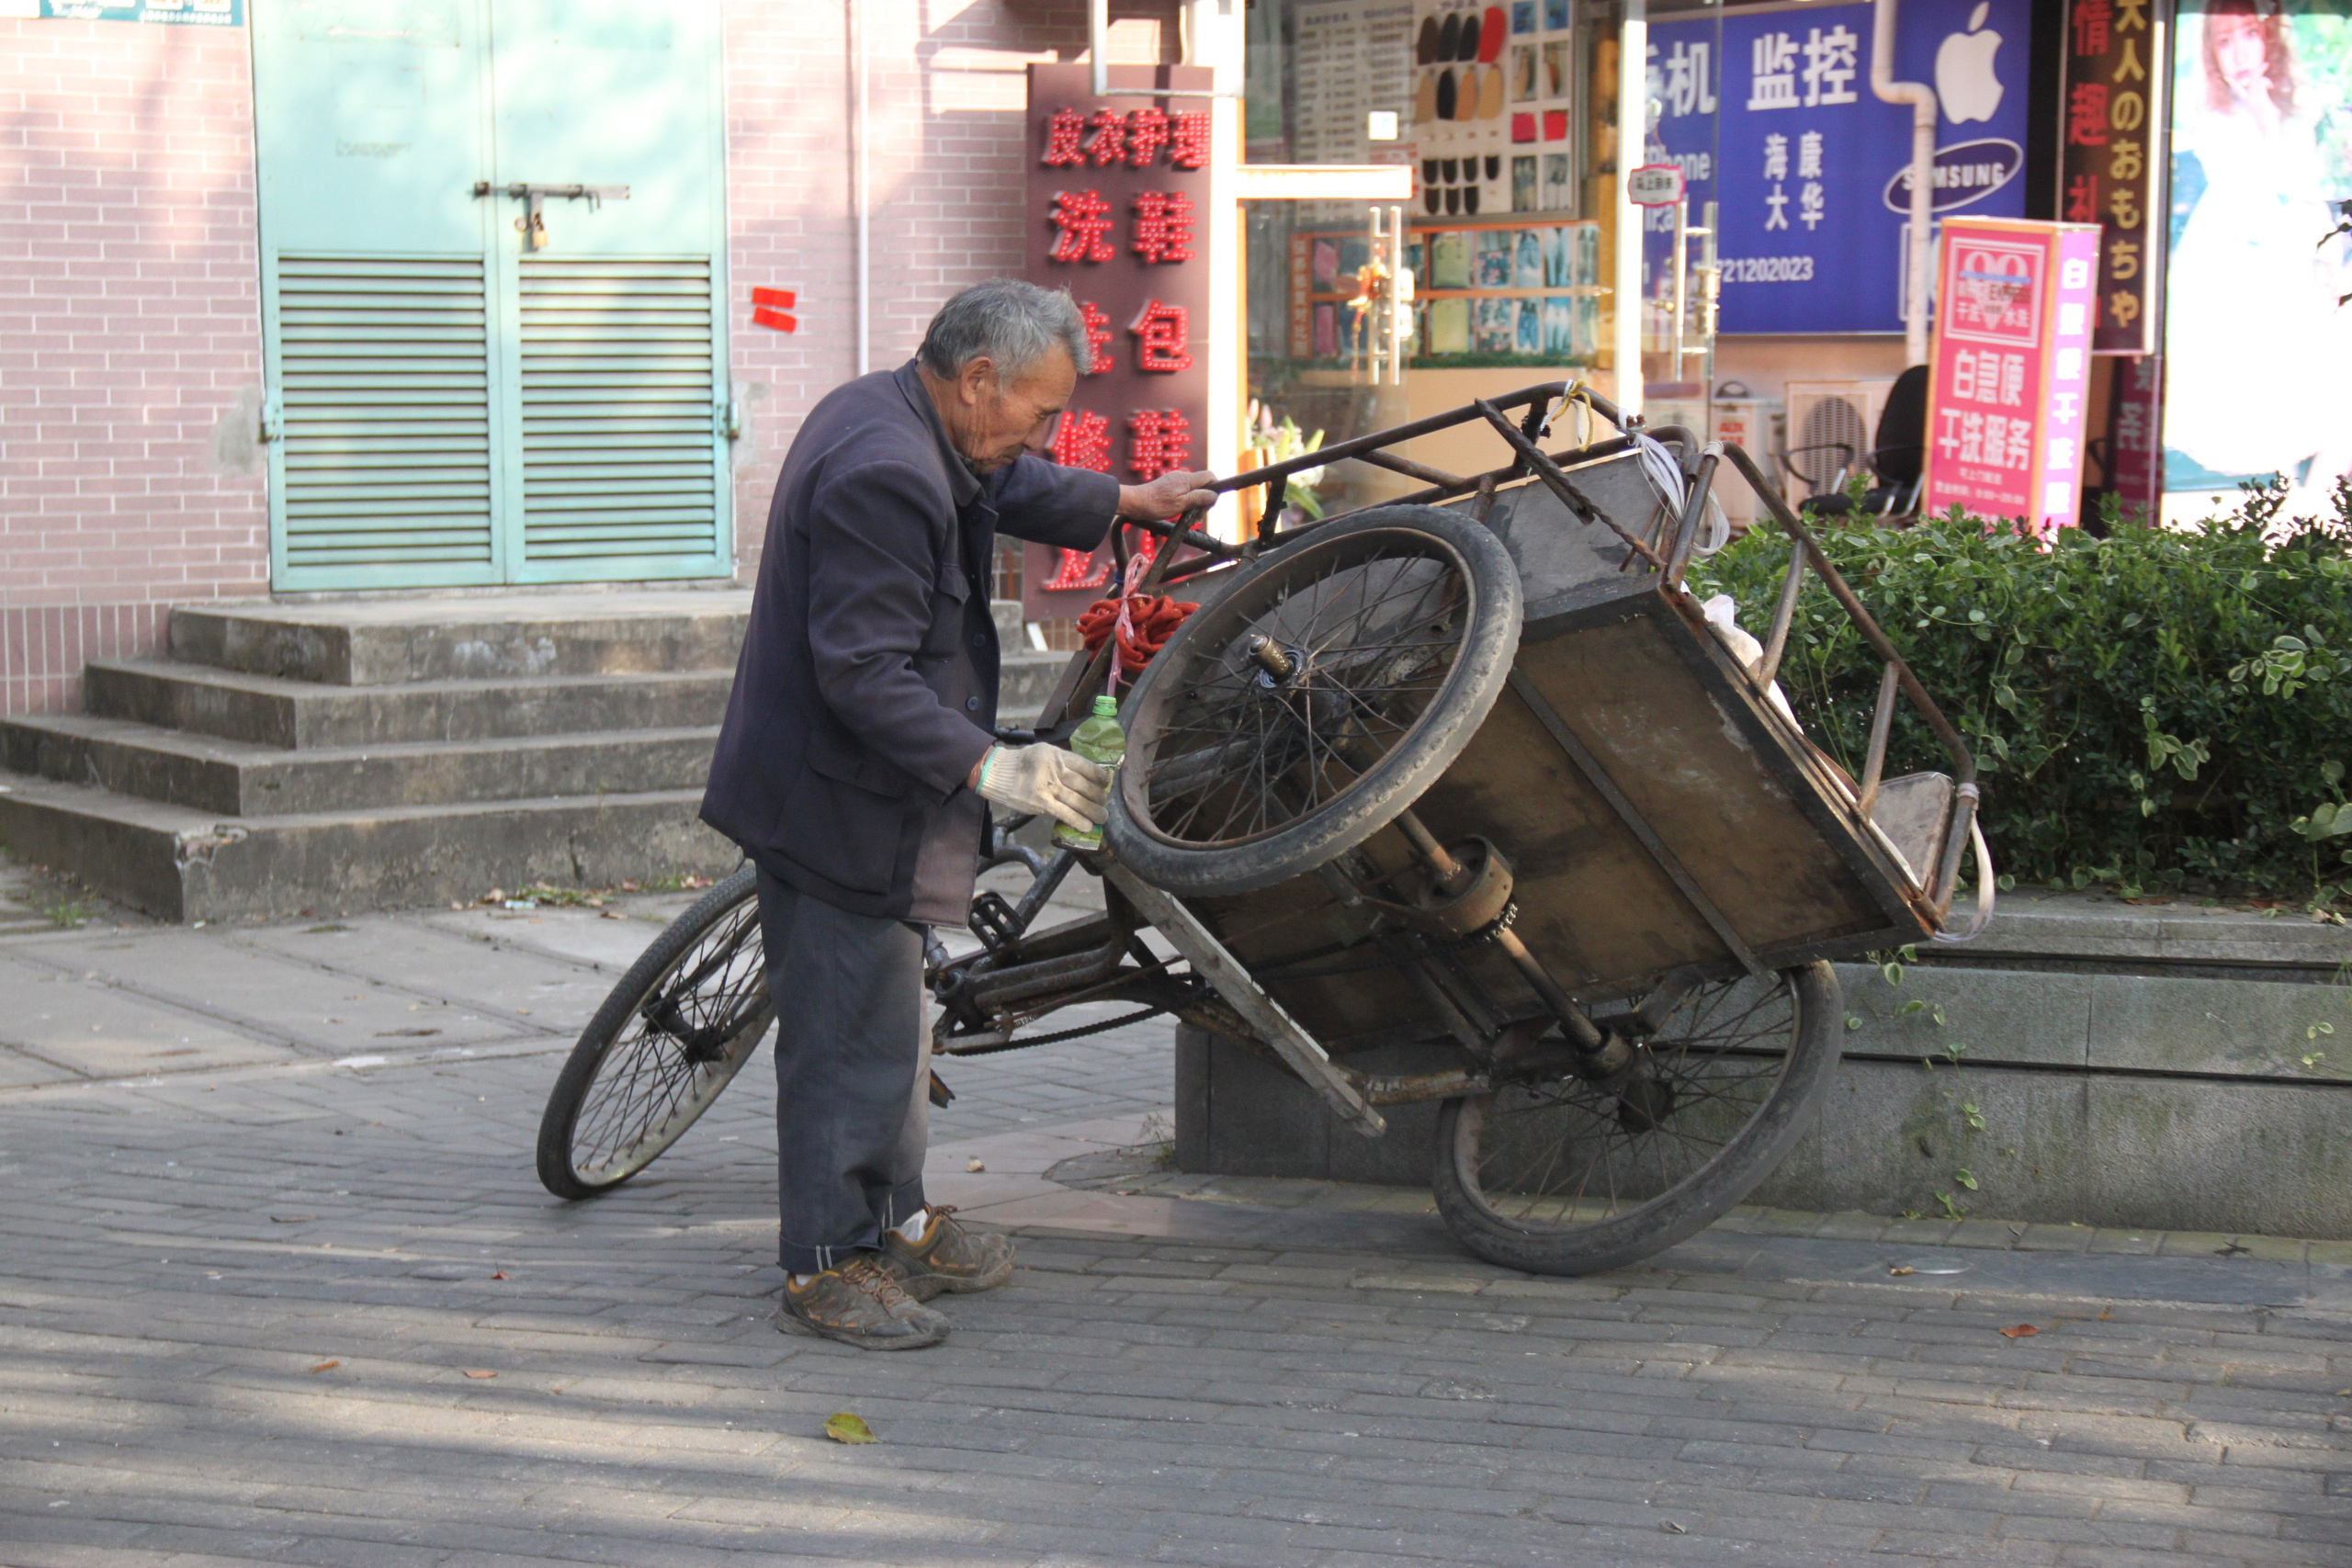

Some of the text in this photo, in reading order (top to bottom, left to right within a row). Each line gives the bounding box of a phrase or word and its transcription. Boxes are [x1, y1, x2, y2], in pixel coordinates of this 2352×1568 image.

[1747, 25, 1859, 111] 监控
[1042, 106, 1211, 168] 皮衣护理
[1765, 181, 1826, 231] 大华
[1902, 161, 2006, 191] SMSUNG
[1048, 188, 1196, 264] 洗鞋
[1952, 348, 2026, 407] 白急便
[1046, 409, 1193, 482] 修鞋
[1937, 406, 2032, 471] 干洗服务
